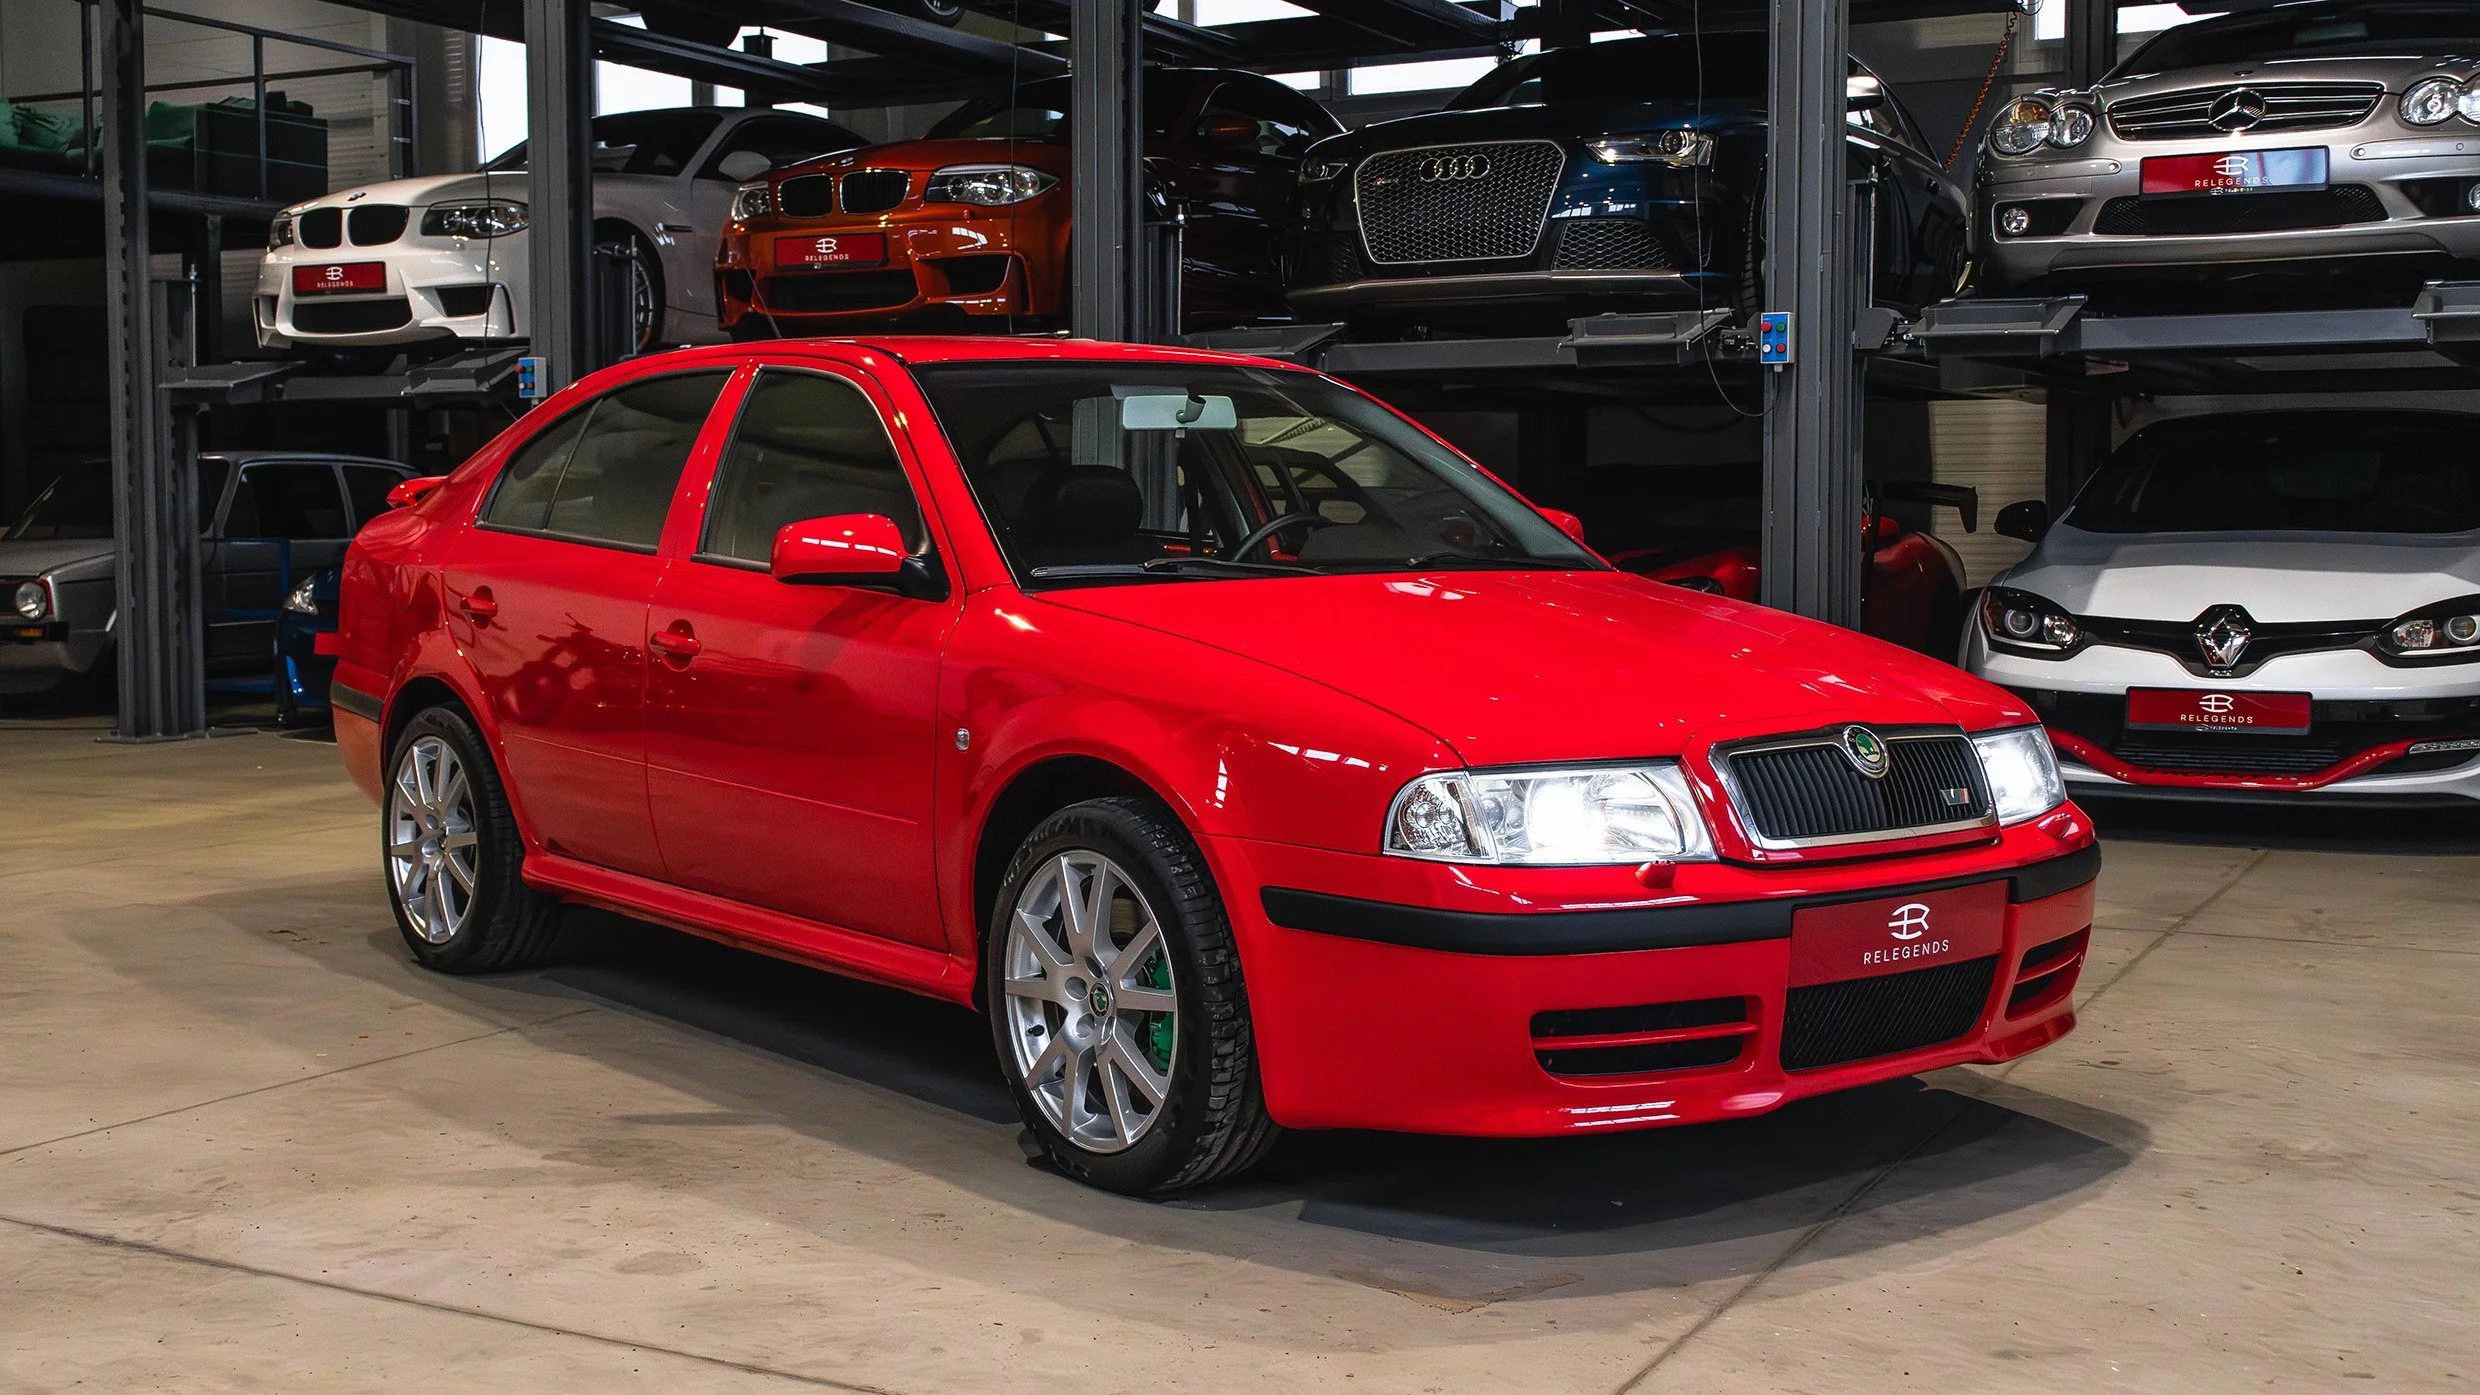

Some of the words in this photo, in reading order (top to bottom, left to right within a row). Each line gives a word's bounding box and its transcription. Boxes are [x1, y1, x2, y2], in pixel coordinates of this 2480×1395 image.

[2194, 176, 2268, 188] RELEGENDS
[2180, 714, 2254, 724] RELEGENDS
[1863, 939, 1950, 965] RELEGENDS
